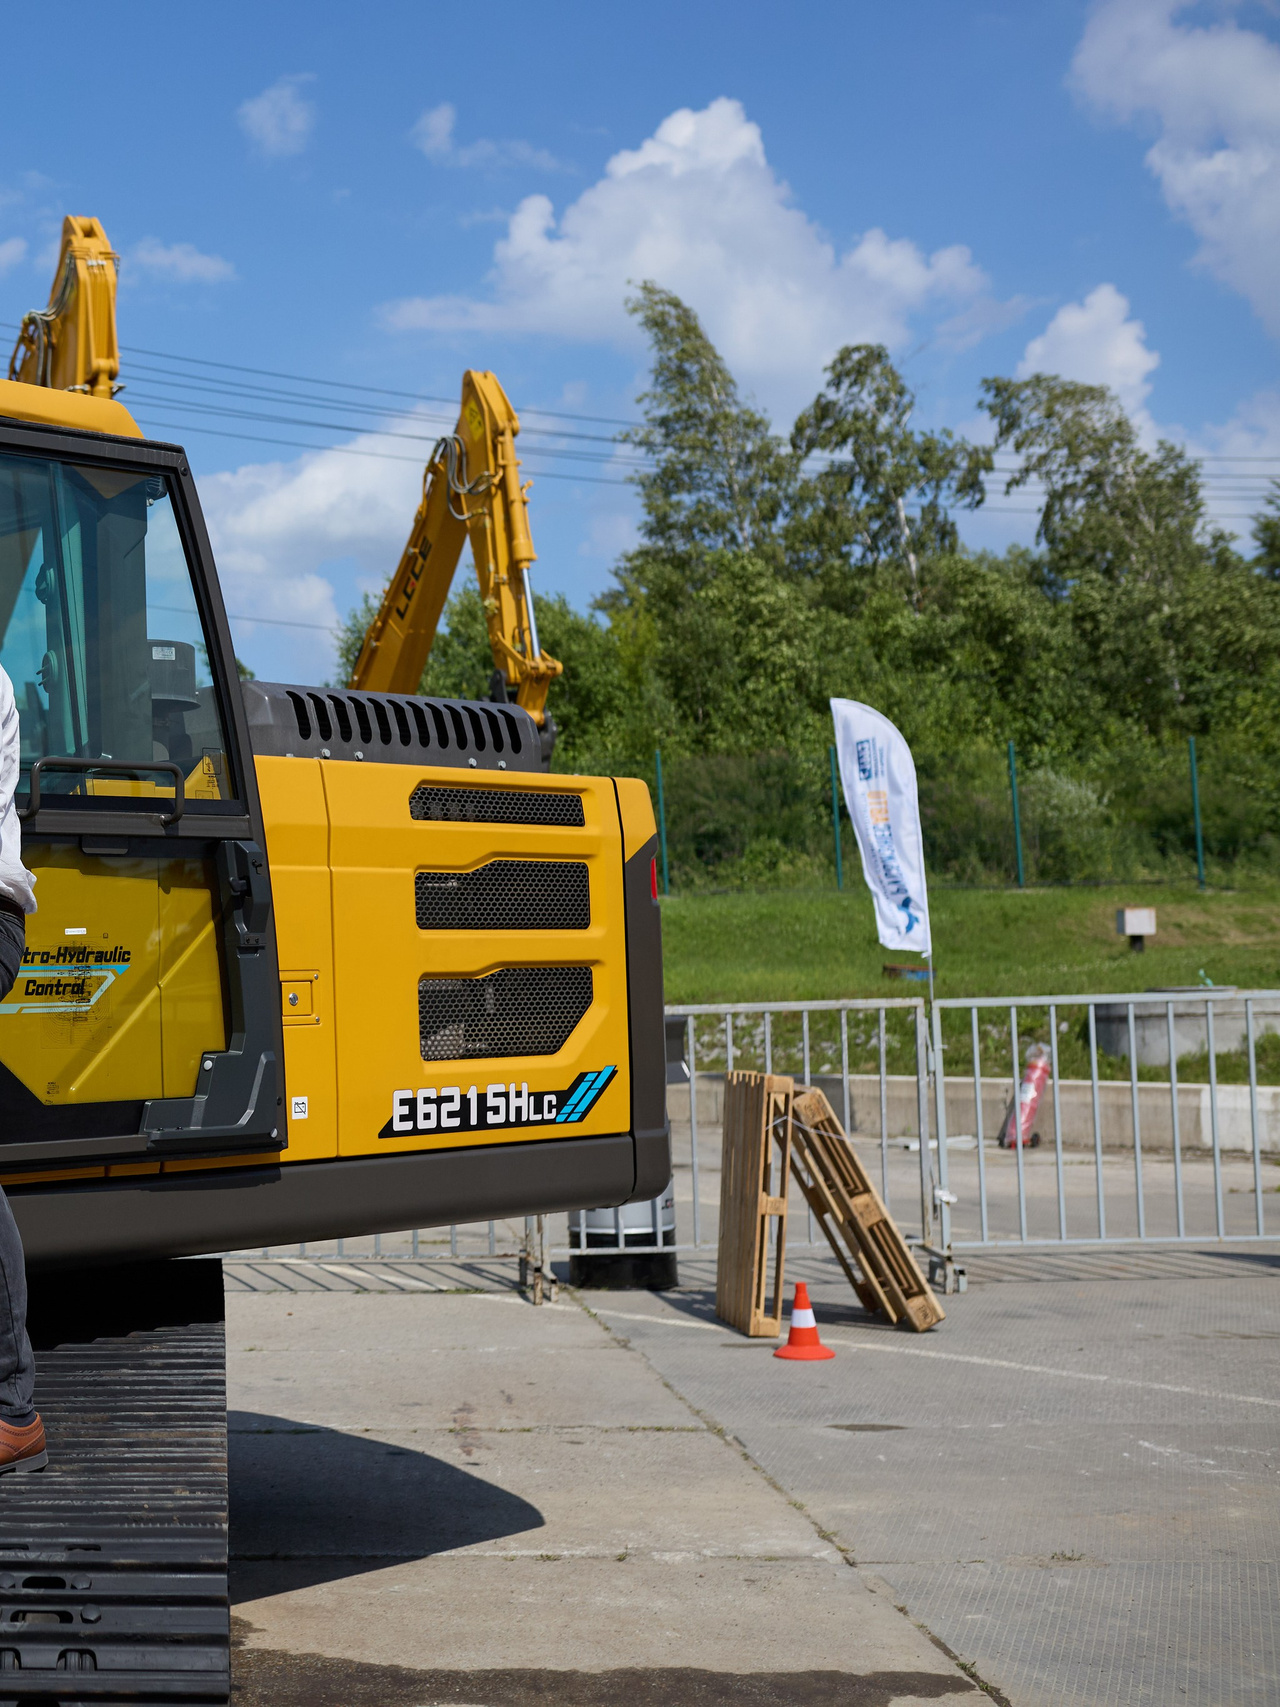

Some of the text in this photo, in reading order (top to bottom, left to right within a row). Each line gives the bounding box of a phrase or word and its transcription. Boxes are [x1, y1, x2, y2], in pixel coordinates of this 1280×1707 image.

[21, 946, 131, 963] tro-Hydraulic
[25, 979, 86, 995] Control
[392, 1081, 558, 1132] E6215HLC
